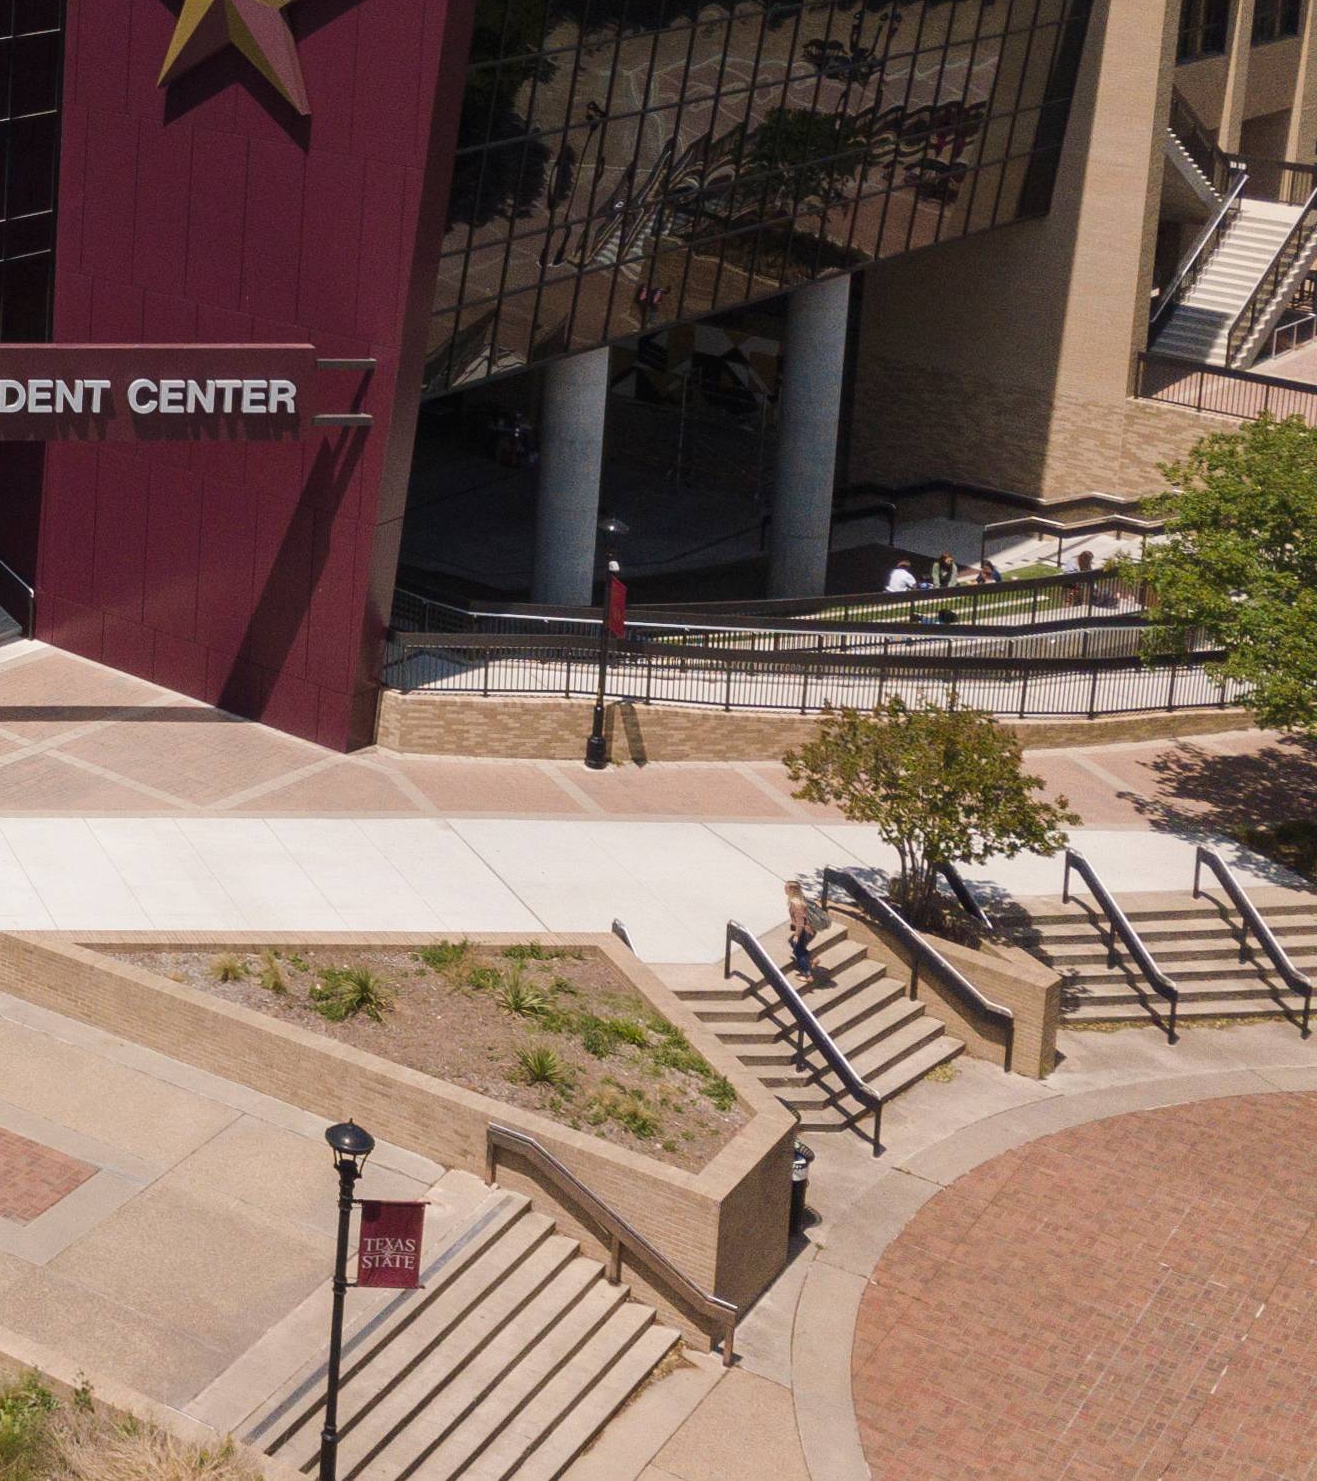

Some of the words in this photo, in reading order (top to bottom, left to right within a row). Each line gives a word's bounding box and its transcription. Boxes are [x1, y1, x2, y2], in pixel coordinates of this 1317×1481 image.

[127, 378, 297, 415] CENTER
[363, 1237, 415, 1252] TEXAS
[362, 1254, 415, 1269] STATE
